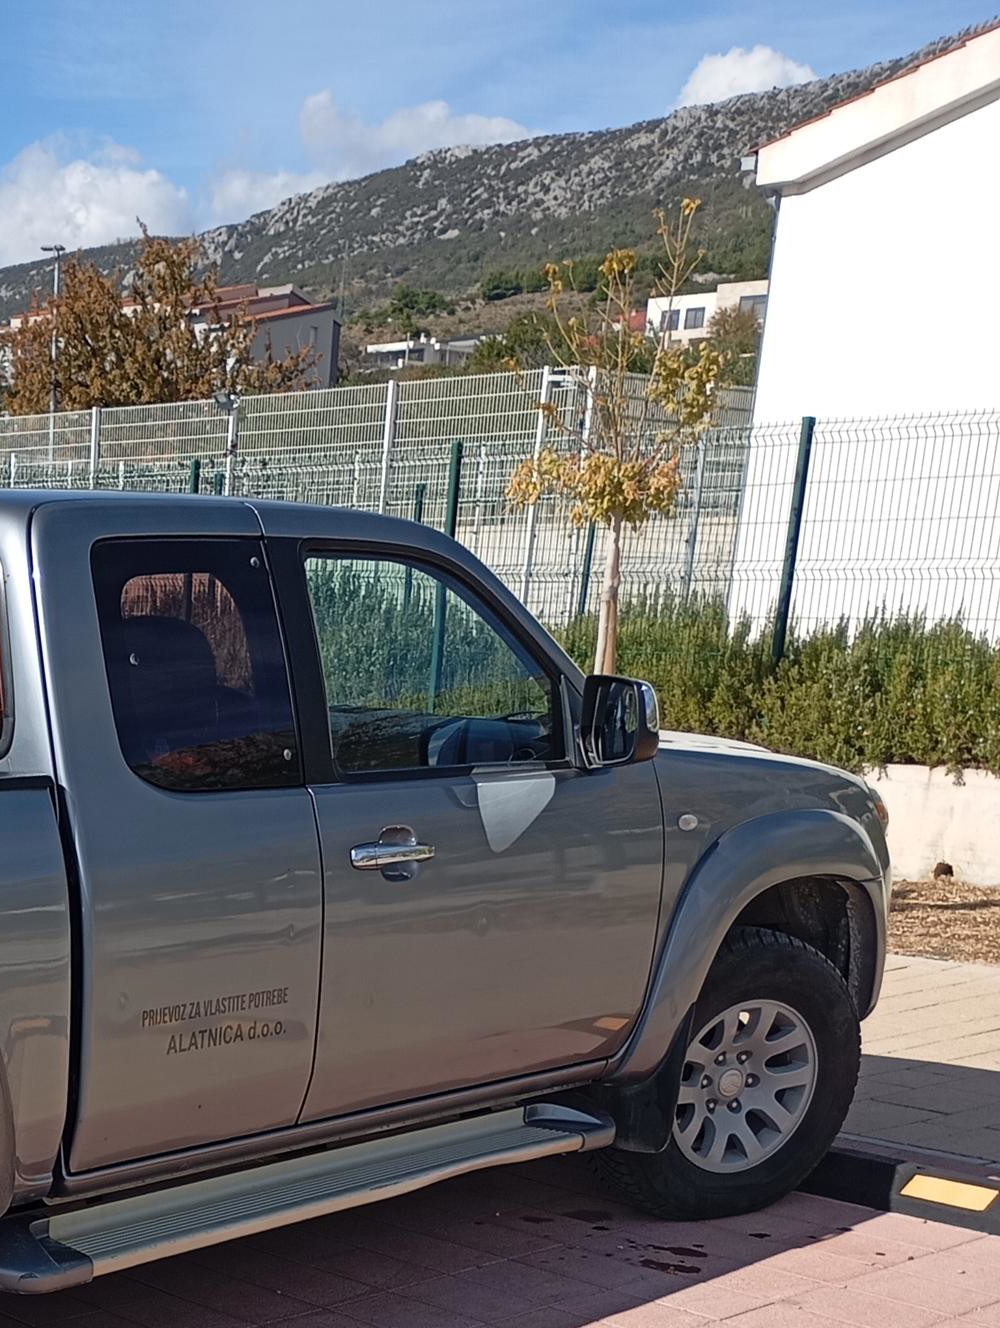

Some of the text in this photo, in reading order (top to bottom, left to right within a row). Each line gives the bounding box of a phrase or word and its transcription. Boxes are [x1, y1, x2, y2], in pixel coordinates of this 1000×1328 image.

[141, 987, 289, 1027] PRIJEVOZ ZA VLASTITE POTREBE
[166, 1020, 287, 1055] ALATNICA d.o.o.
